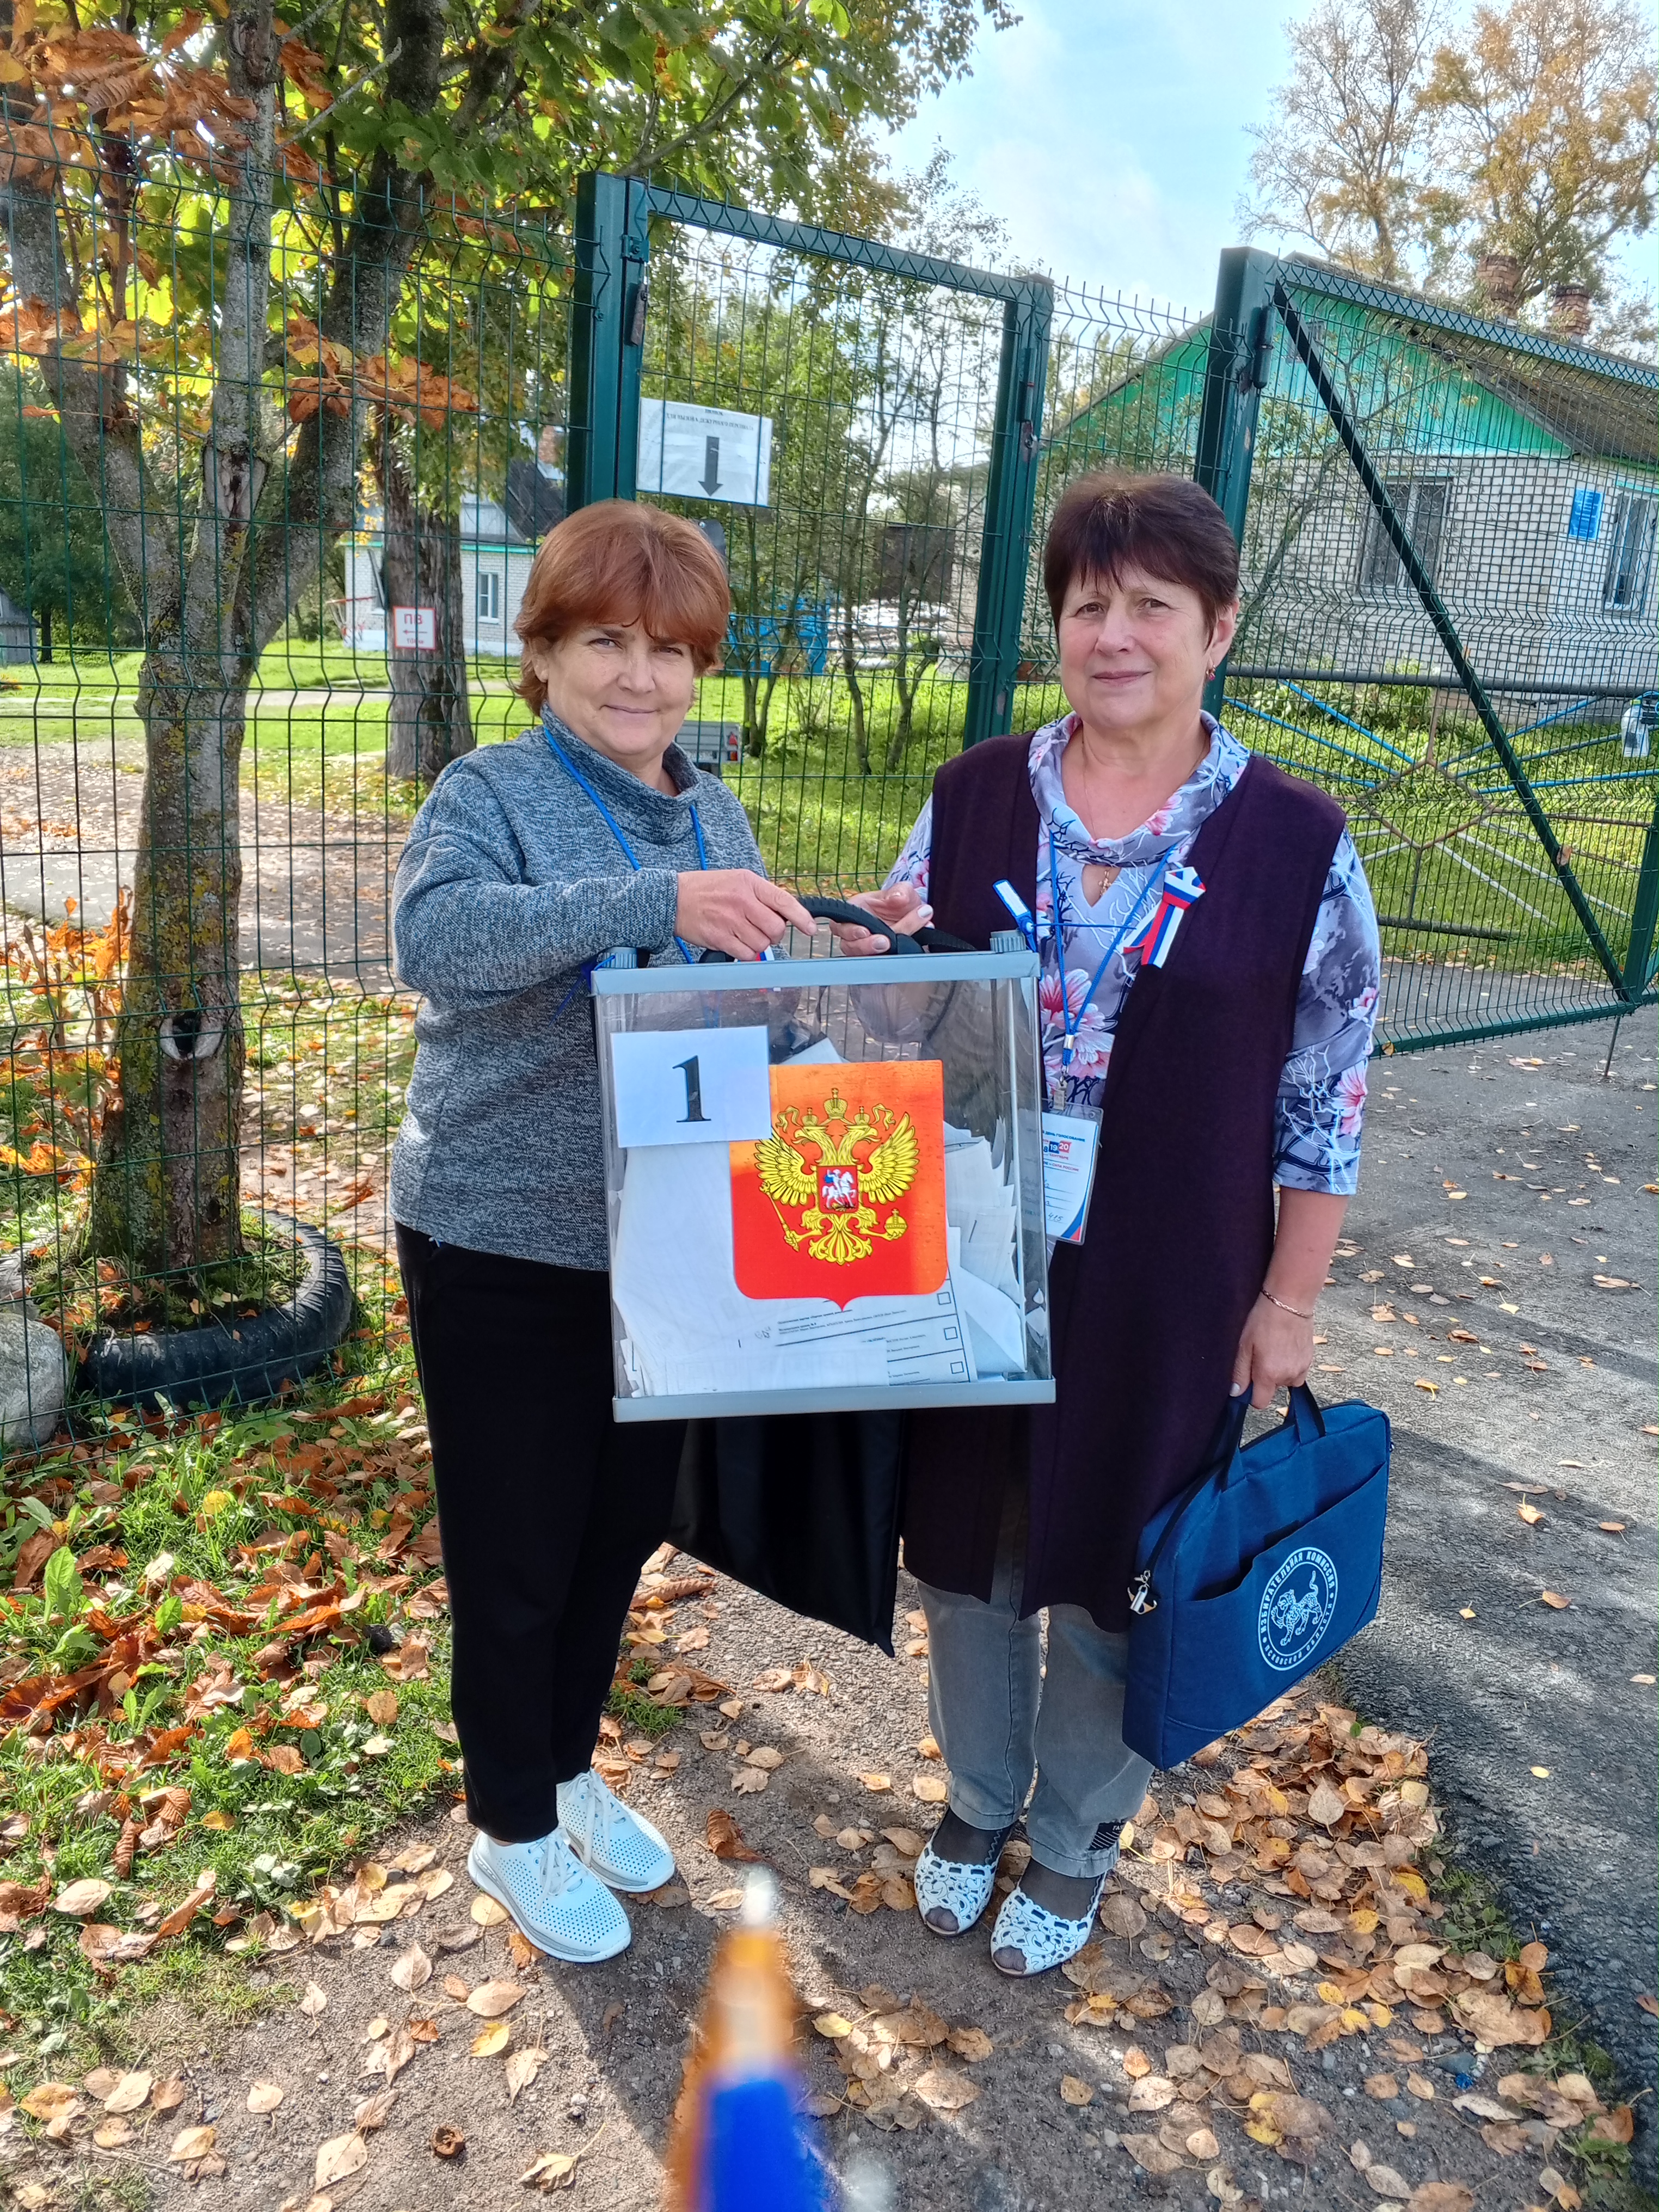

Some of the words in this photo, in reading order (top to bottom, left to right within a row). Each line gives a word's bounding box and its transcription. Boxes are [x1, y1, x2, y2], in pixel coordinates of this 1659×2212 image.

[672, 1055, 711, 1122] 1
[1059, 1142, 1069, 1151] 20
[1260, 1551, 1303, 1634] ИЗБИРАТЕЛЬНАЯ
[1306, 1551, 1335, 1589] КОМИССИЯ
[1264, 1644, 1302, 1666] ПСКОВСКОЙ
[1306, 1603, 1332, 1652] ОБЛАСТИ
